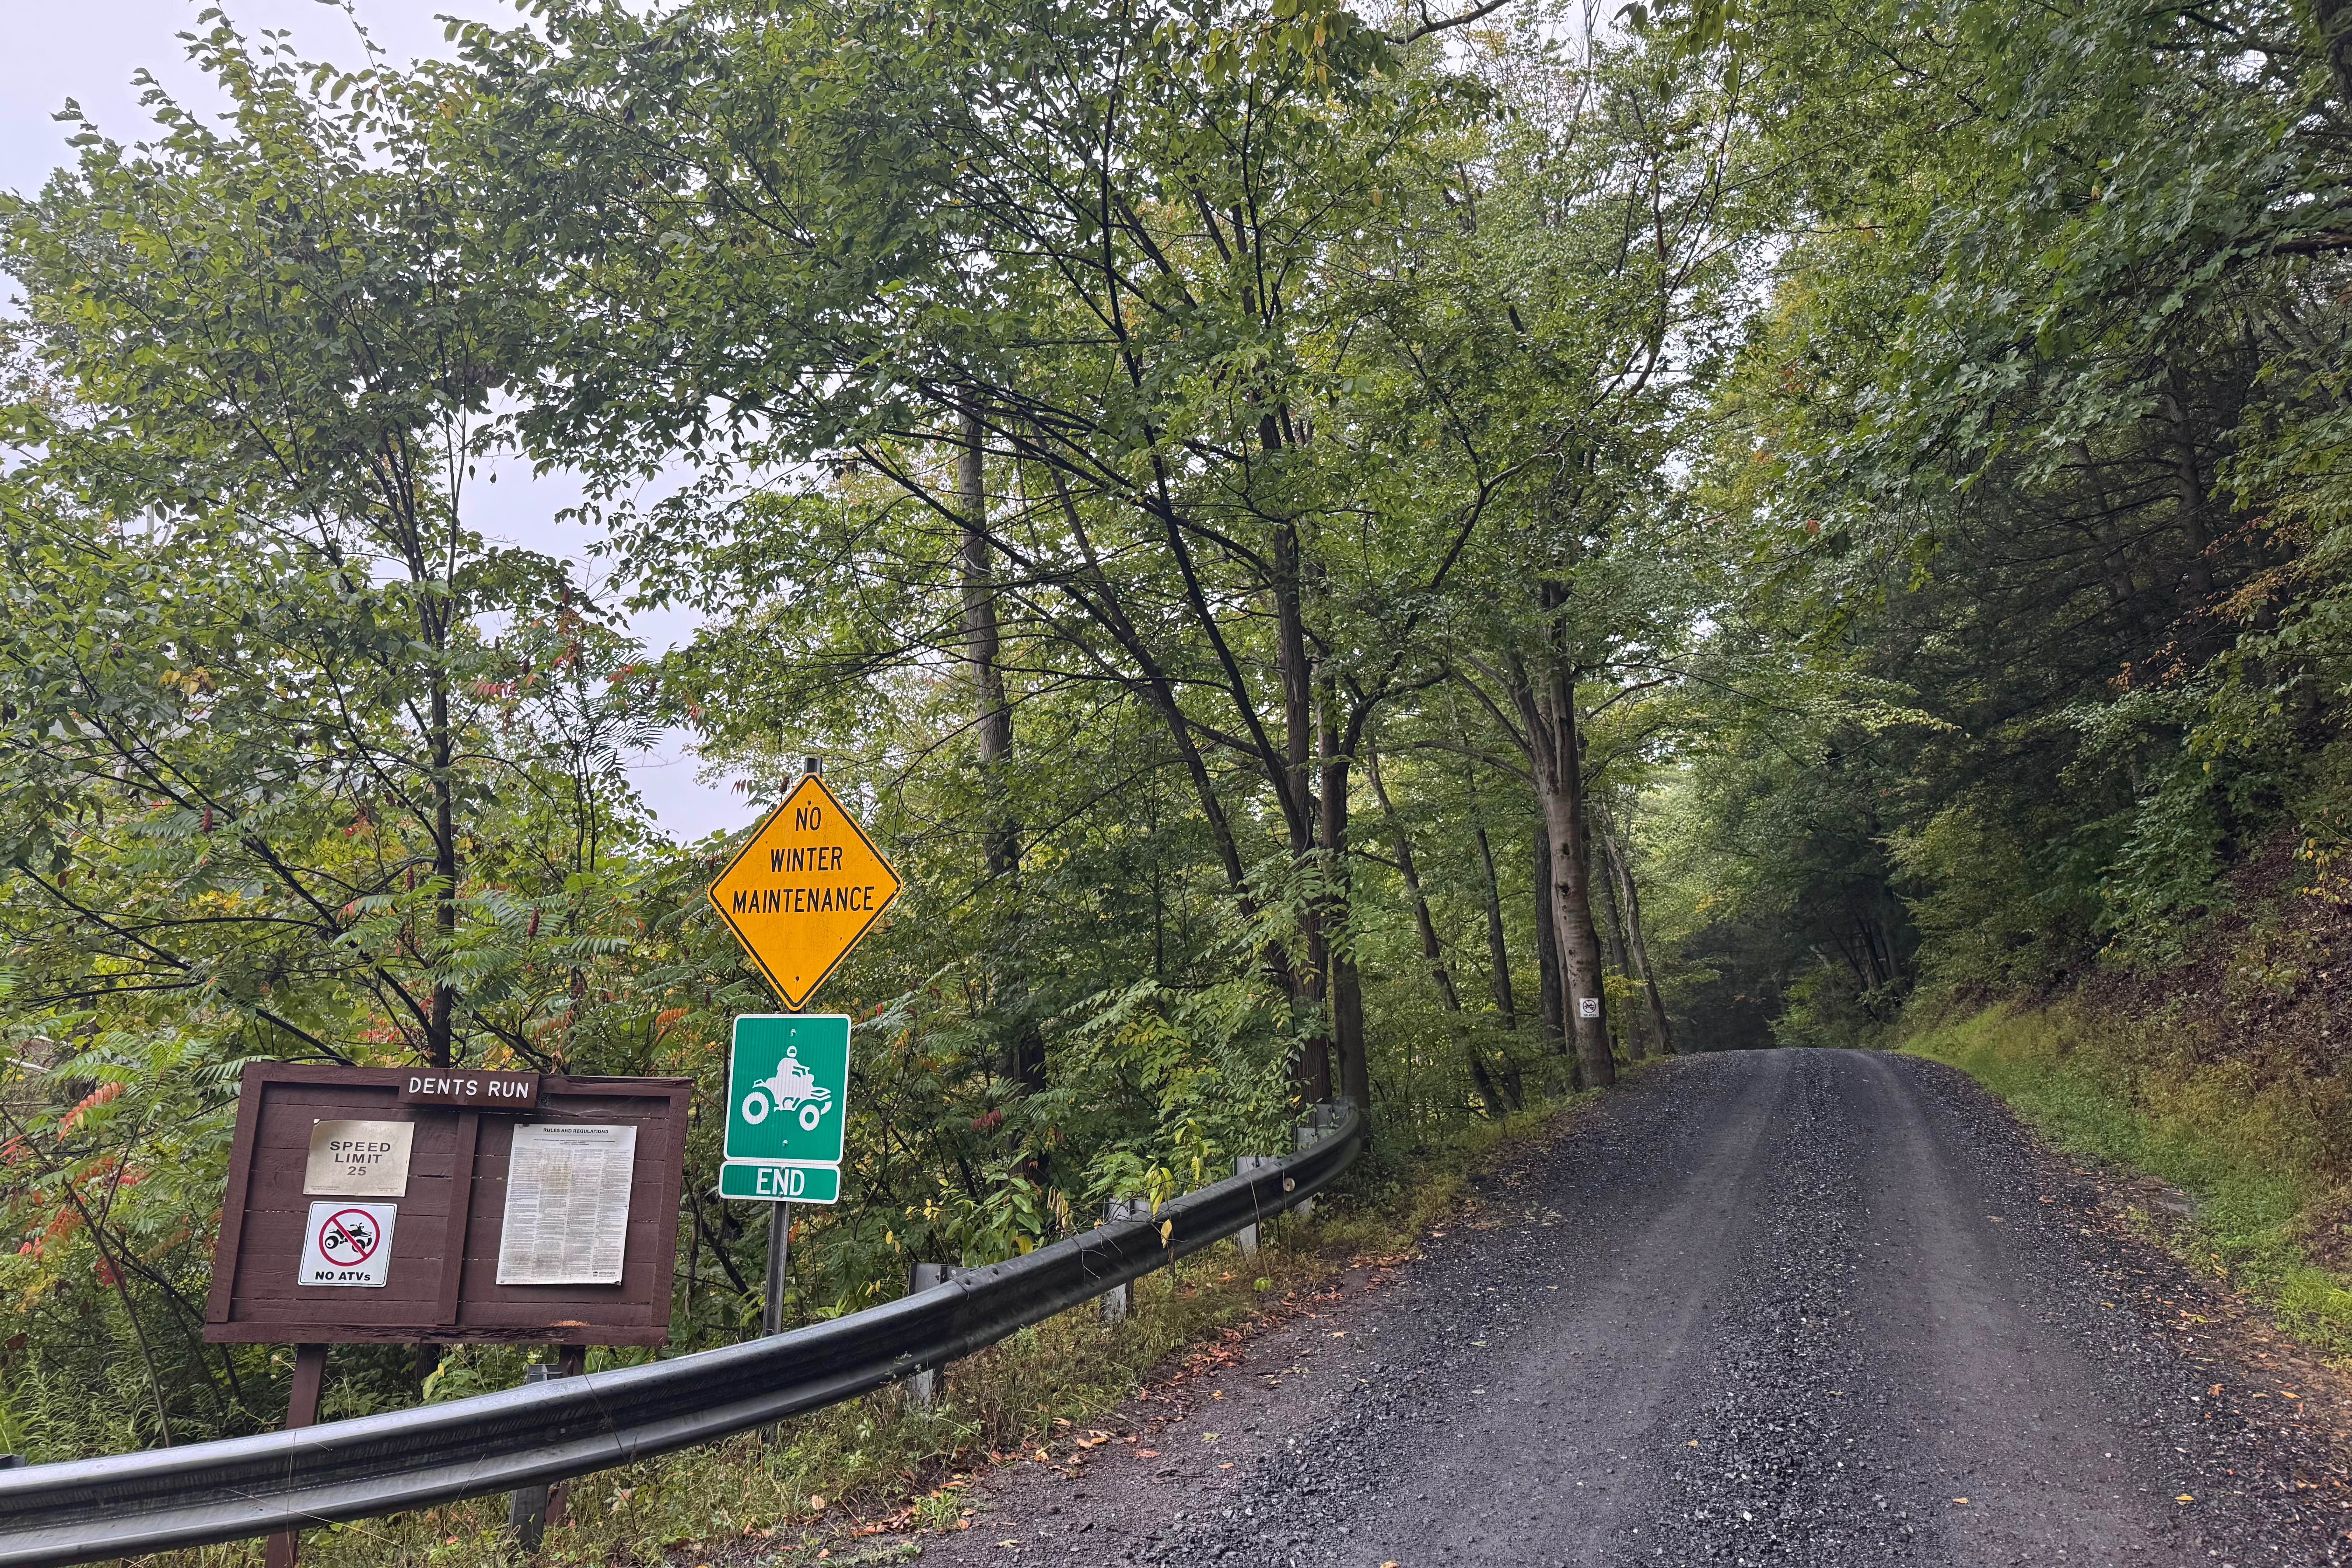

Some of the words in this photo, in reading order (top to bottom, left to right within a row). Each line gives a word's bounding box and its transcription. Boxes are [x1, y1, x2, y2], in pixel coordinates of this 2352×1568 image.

[796, 807, 821, 831] NO
[771, 847, 843, 873] WINTER
[733, 887, 875, 914] MAINTENANCE
[408, 1077, 478, 1096] DENTS
[488, 1081, 529, 1098] RUN
[330, 1141, 391, 1152] SPEED
[335, 1153, 382, 1164] LIMIT
[347, 1166, 366, 1176] 25
[756, 1168, 805, 1196] END
[315, 1272, 334, 1280] NO
[338, 1272, 371, 1281] ATVs
